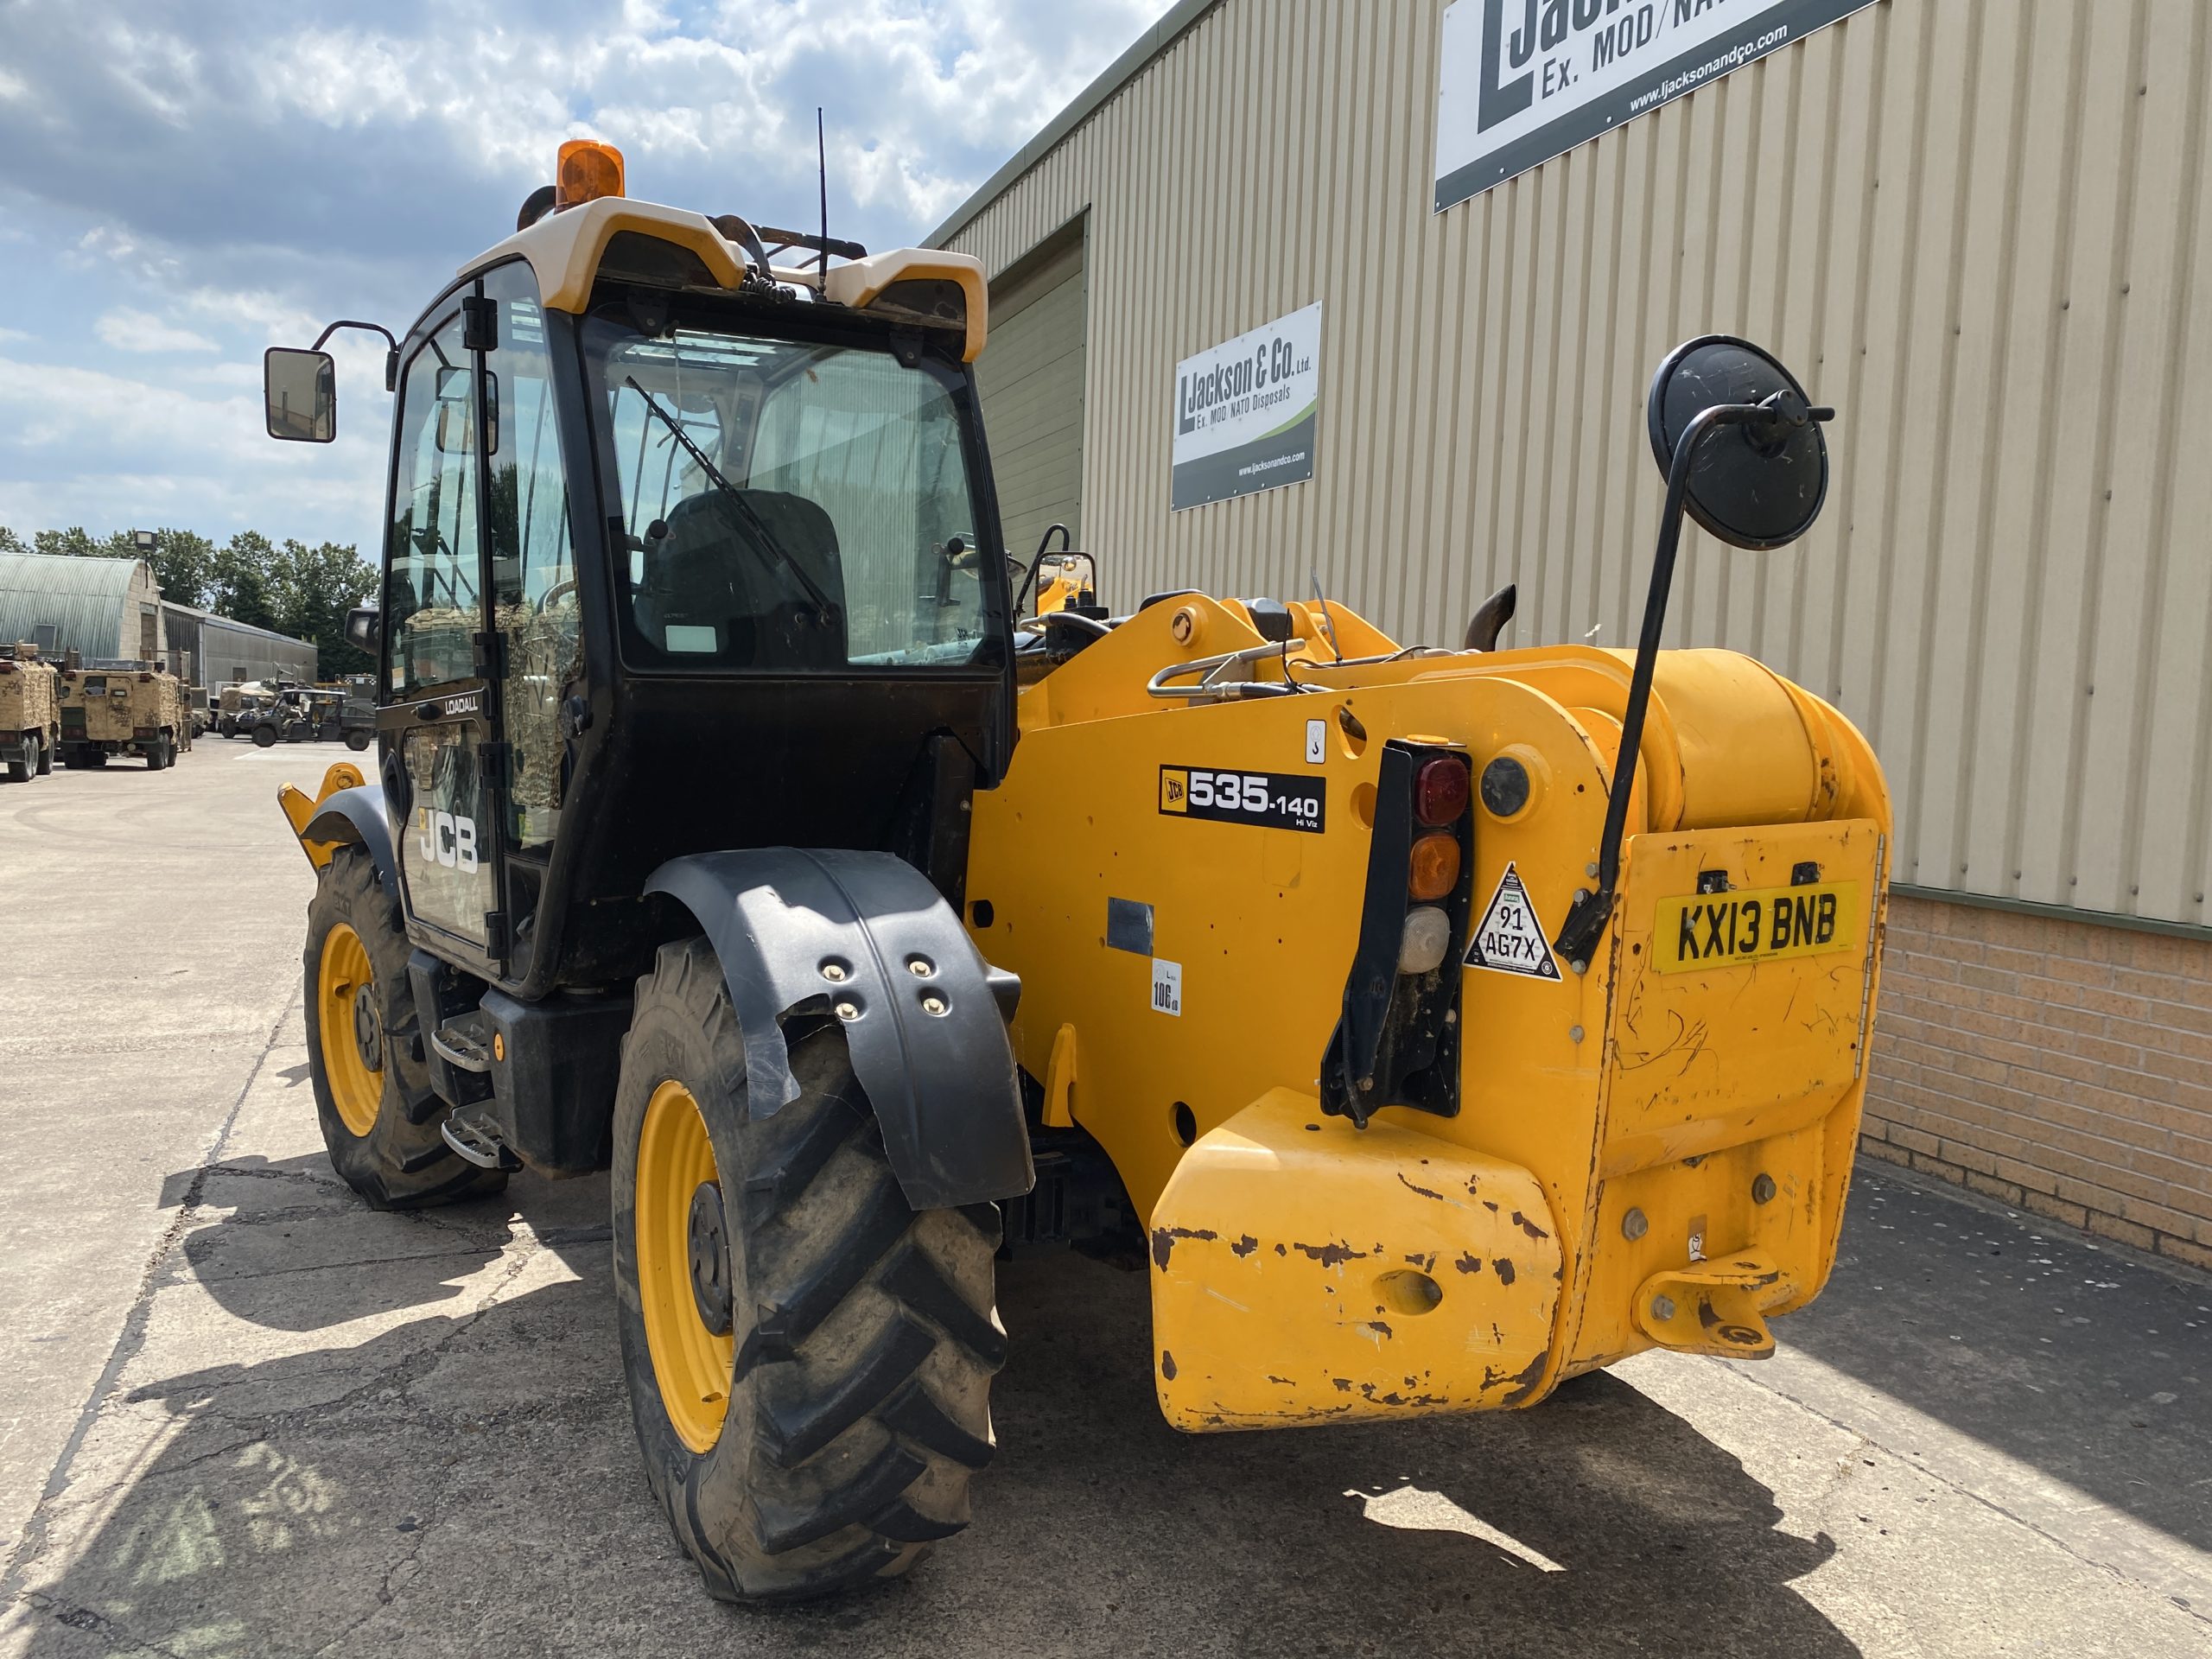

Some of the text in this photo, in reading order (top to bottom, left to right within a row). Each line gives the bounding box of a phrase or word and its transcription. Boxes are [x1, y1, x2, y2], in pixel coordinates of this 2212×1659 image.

[1541, 57, 1579, 99] Ex.
[1630, 24, 1789, 111] www.ljacksonandco.com
[1255, 344, 1267, 388] &
[1271, 337, 1294, 384] Co.
[1297, 357, 1312, 374] Ltd.
[1197, 414, 1208, 429] Ex.
[1253, 384, 1291, 411] Disposals
[1239, 452, 1305, 476] www.ljacksonandco.com
[444, 696, 479, 715] LOADALL
[1166, 780, 1184, 801] JCB
[420, 809, 479, 874] JCB
[1500, 906, 1523, 931] 91
[1678, 893, 1837, 962] KX13 BNB
[1485, 931, 1535, 961] AG7X
[1154, 982, 1171, 1008] 106
